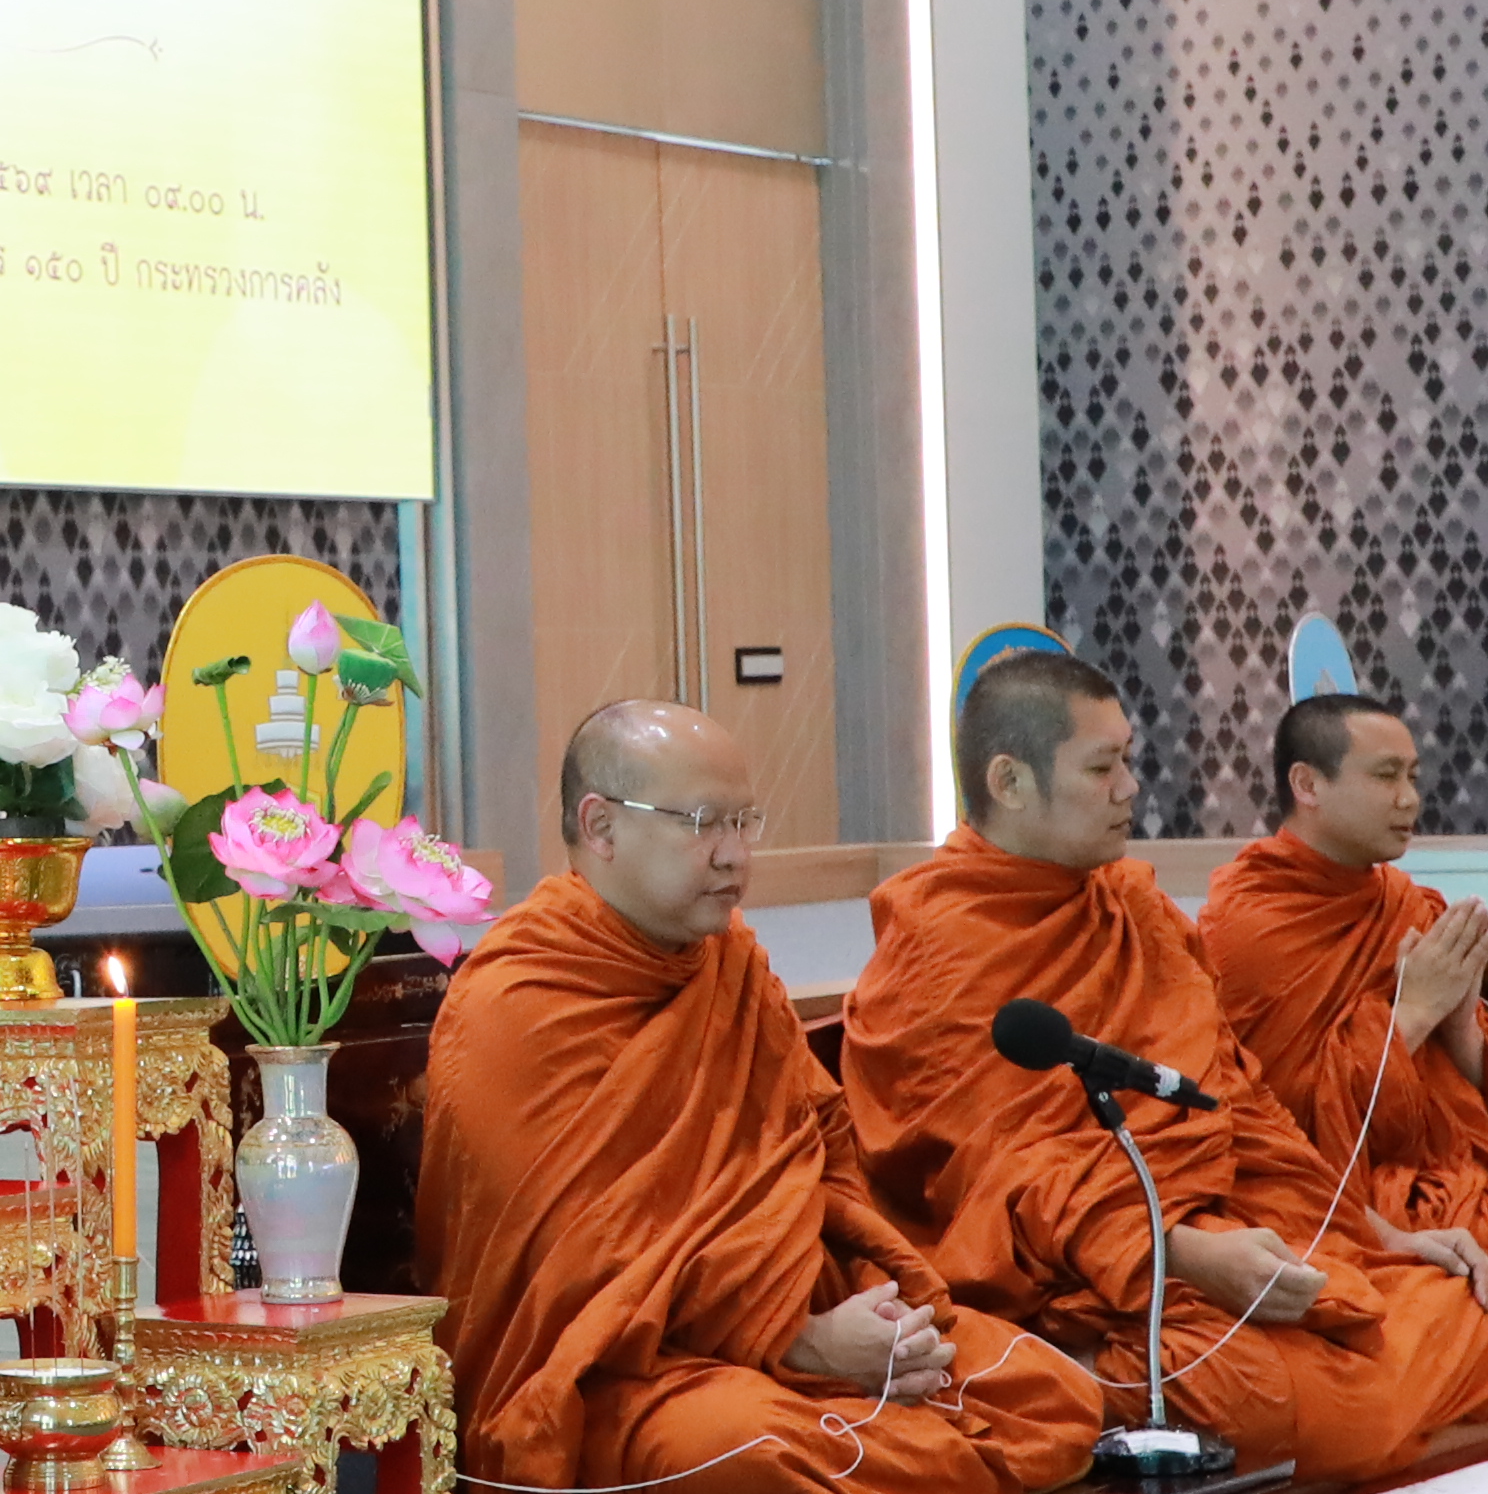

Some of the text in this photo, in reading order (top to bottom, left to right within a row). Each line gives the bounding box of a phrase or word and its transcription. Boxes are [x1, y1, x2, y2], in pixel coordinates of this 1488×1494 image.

[69, 167, 129, 205] เวลา
[239, 189, 266, 221] น.
[24, 250, 84, 284] ๑๕๐
[99, 240, 122, 287] ปี
[135, 260, 343, 307] กระทรวงการคลัง
